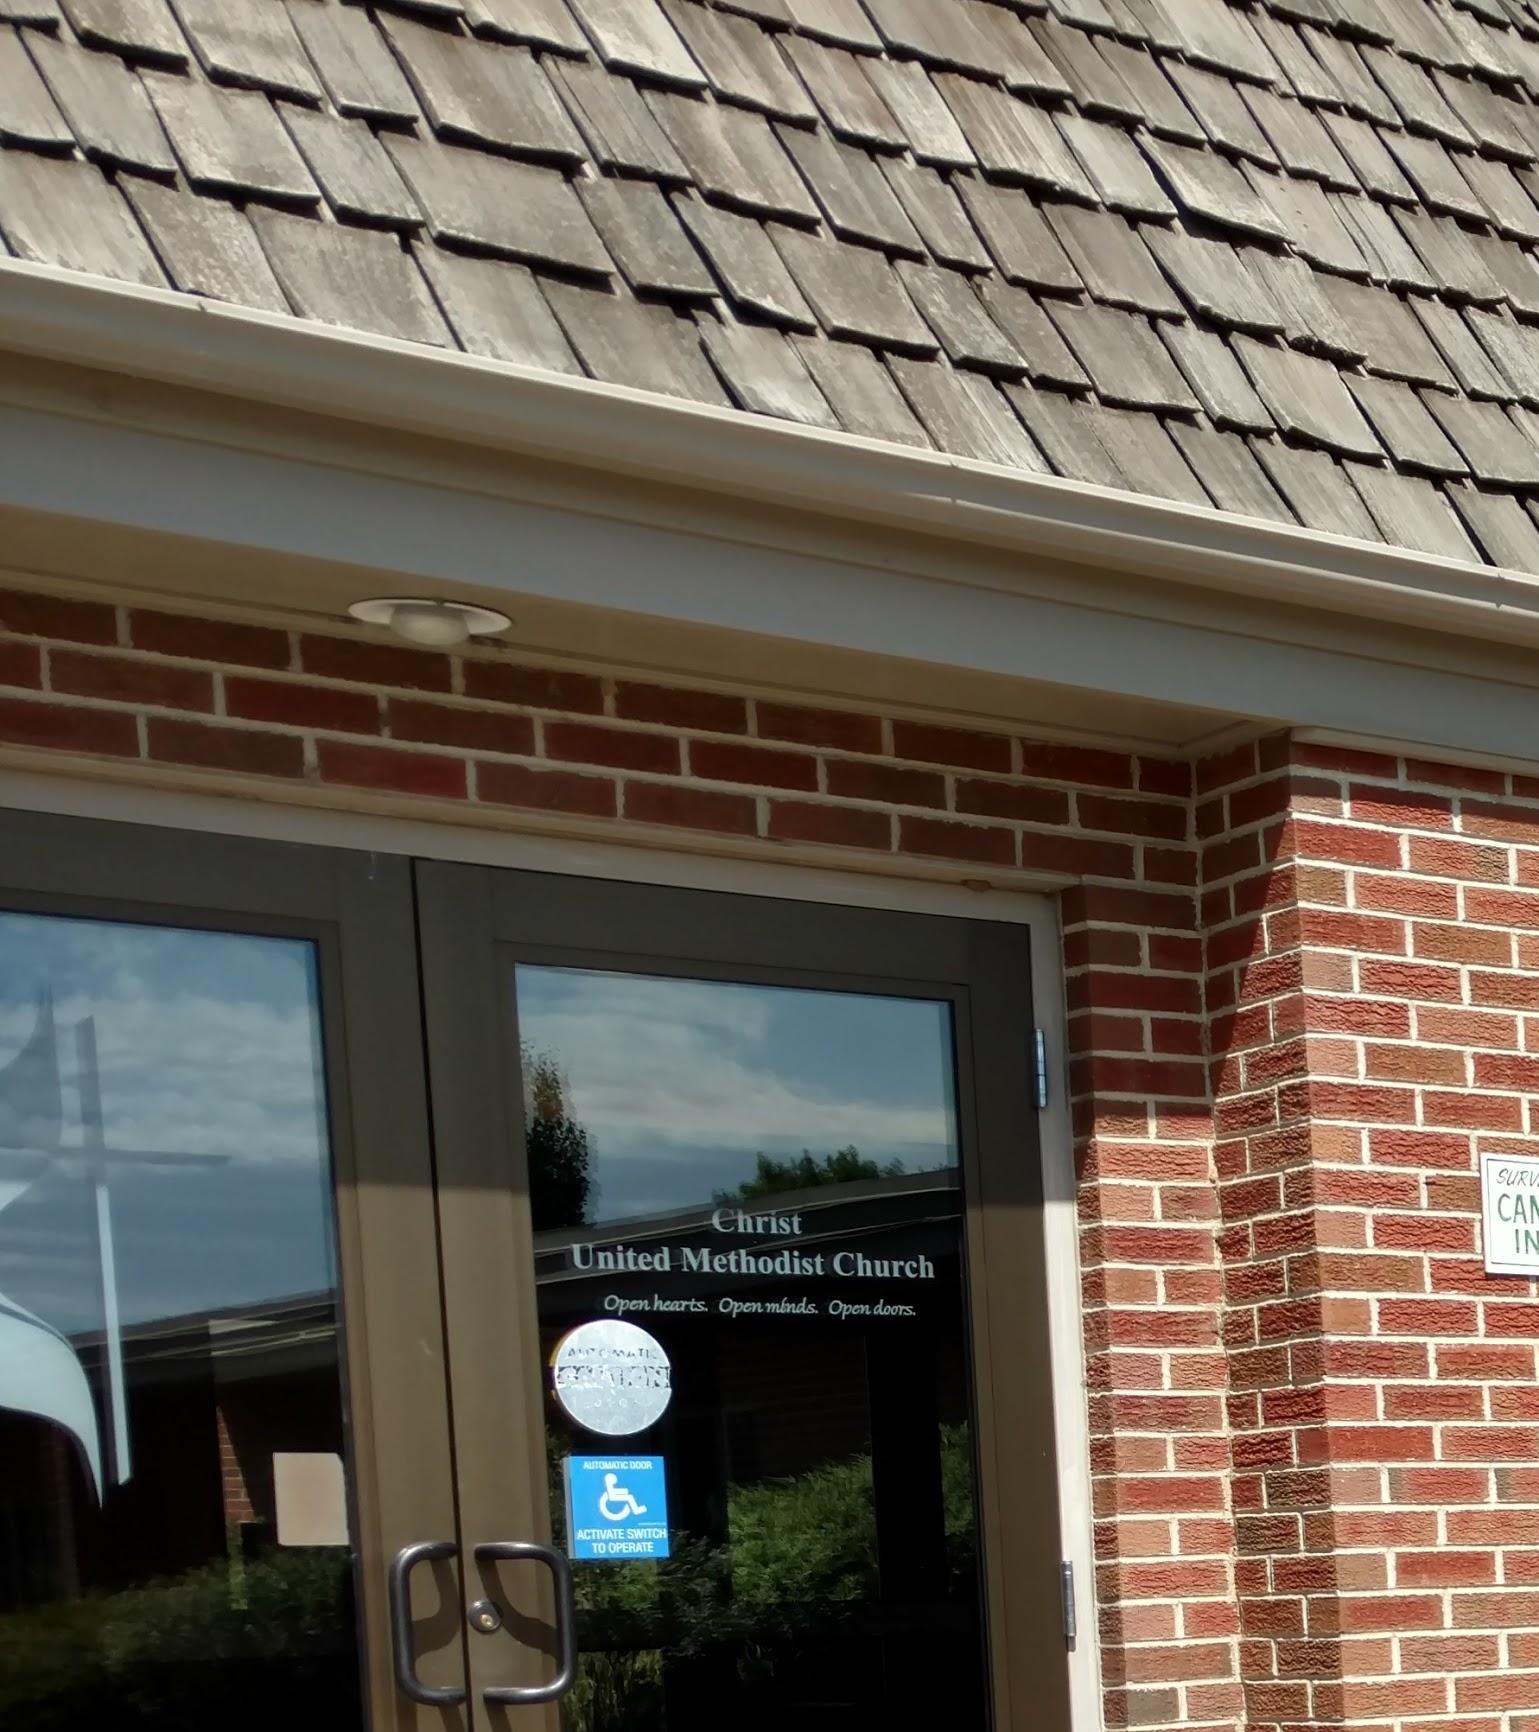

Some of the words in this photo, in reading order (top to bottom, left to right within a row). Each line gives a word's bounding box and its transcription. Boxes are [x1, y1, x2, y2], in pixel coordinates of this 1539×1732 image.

[711, 1208, 803, 1235] Christ
[571, 1243, 671, 1272] United
[680, 1247, 825, 1276] Methodist
[833, 1252, 935, 1279] Church
[603, 1294, 650, 1316] Open
[652, 1294, 709, 1313] hearts.
[718, 1297, 763, 1319] Open
[766, 1297, 820, 1314] minds.
[828, 1300, 871, 1320] Open
[873, 1299, 917, 1317] doors.
[583, 1460, 629, 1470] AUTOMATIC
[630, 1460, 653, 1470] DOOR
[577, 1528, 625, 1540] ACTIVATE
[627, 1528, 667, 1539] SWITCH
[591, 1543, 606, 1554] TO
[608, 1542, 654, 1553] OPERATE
